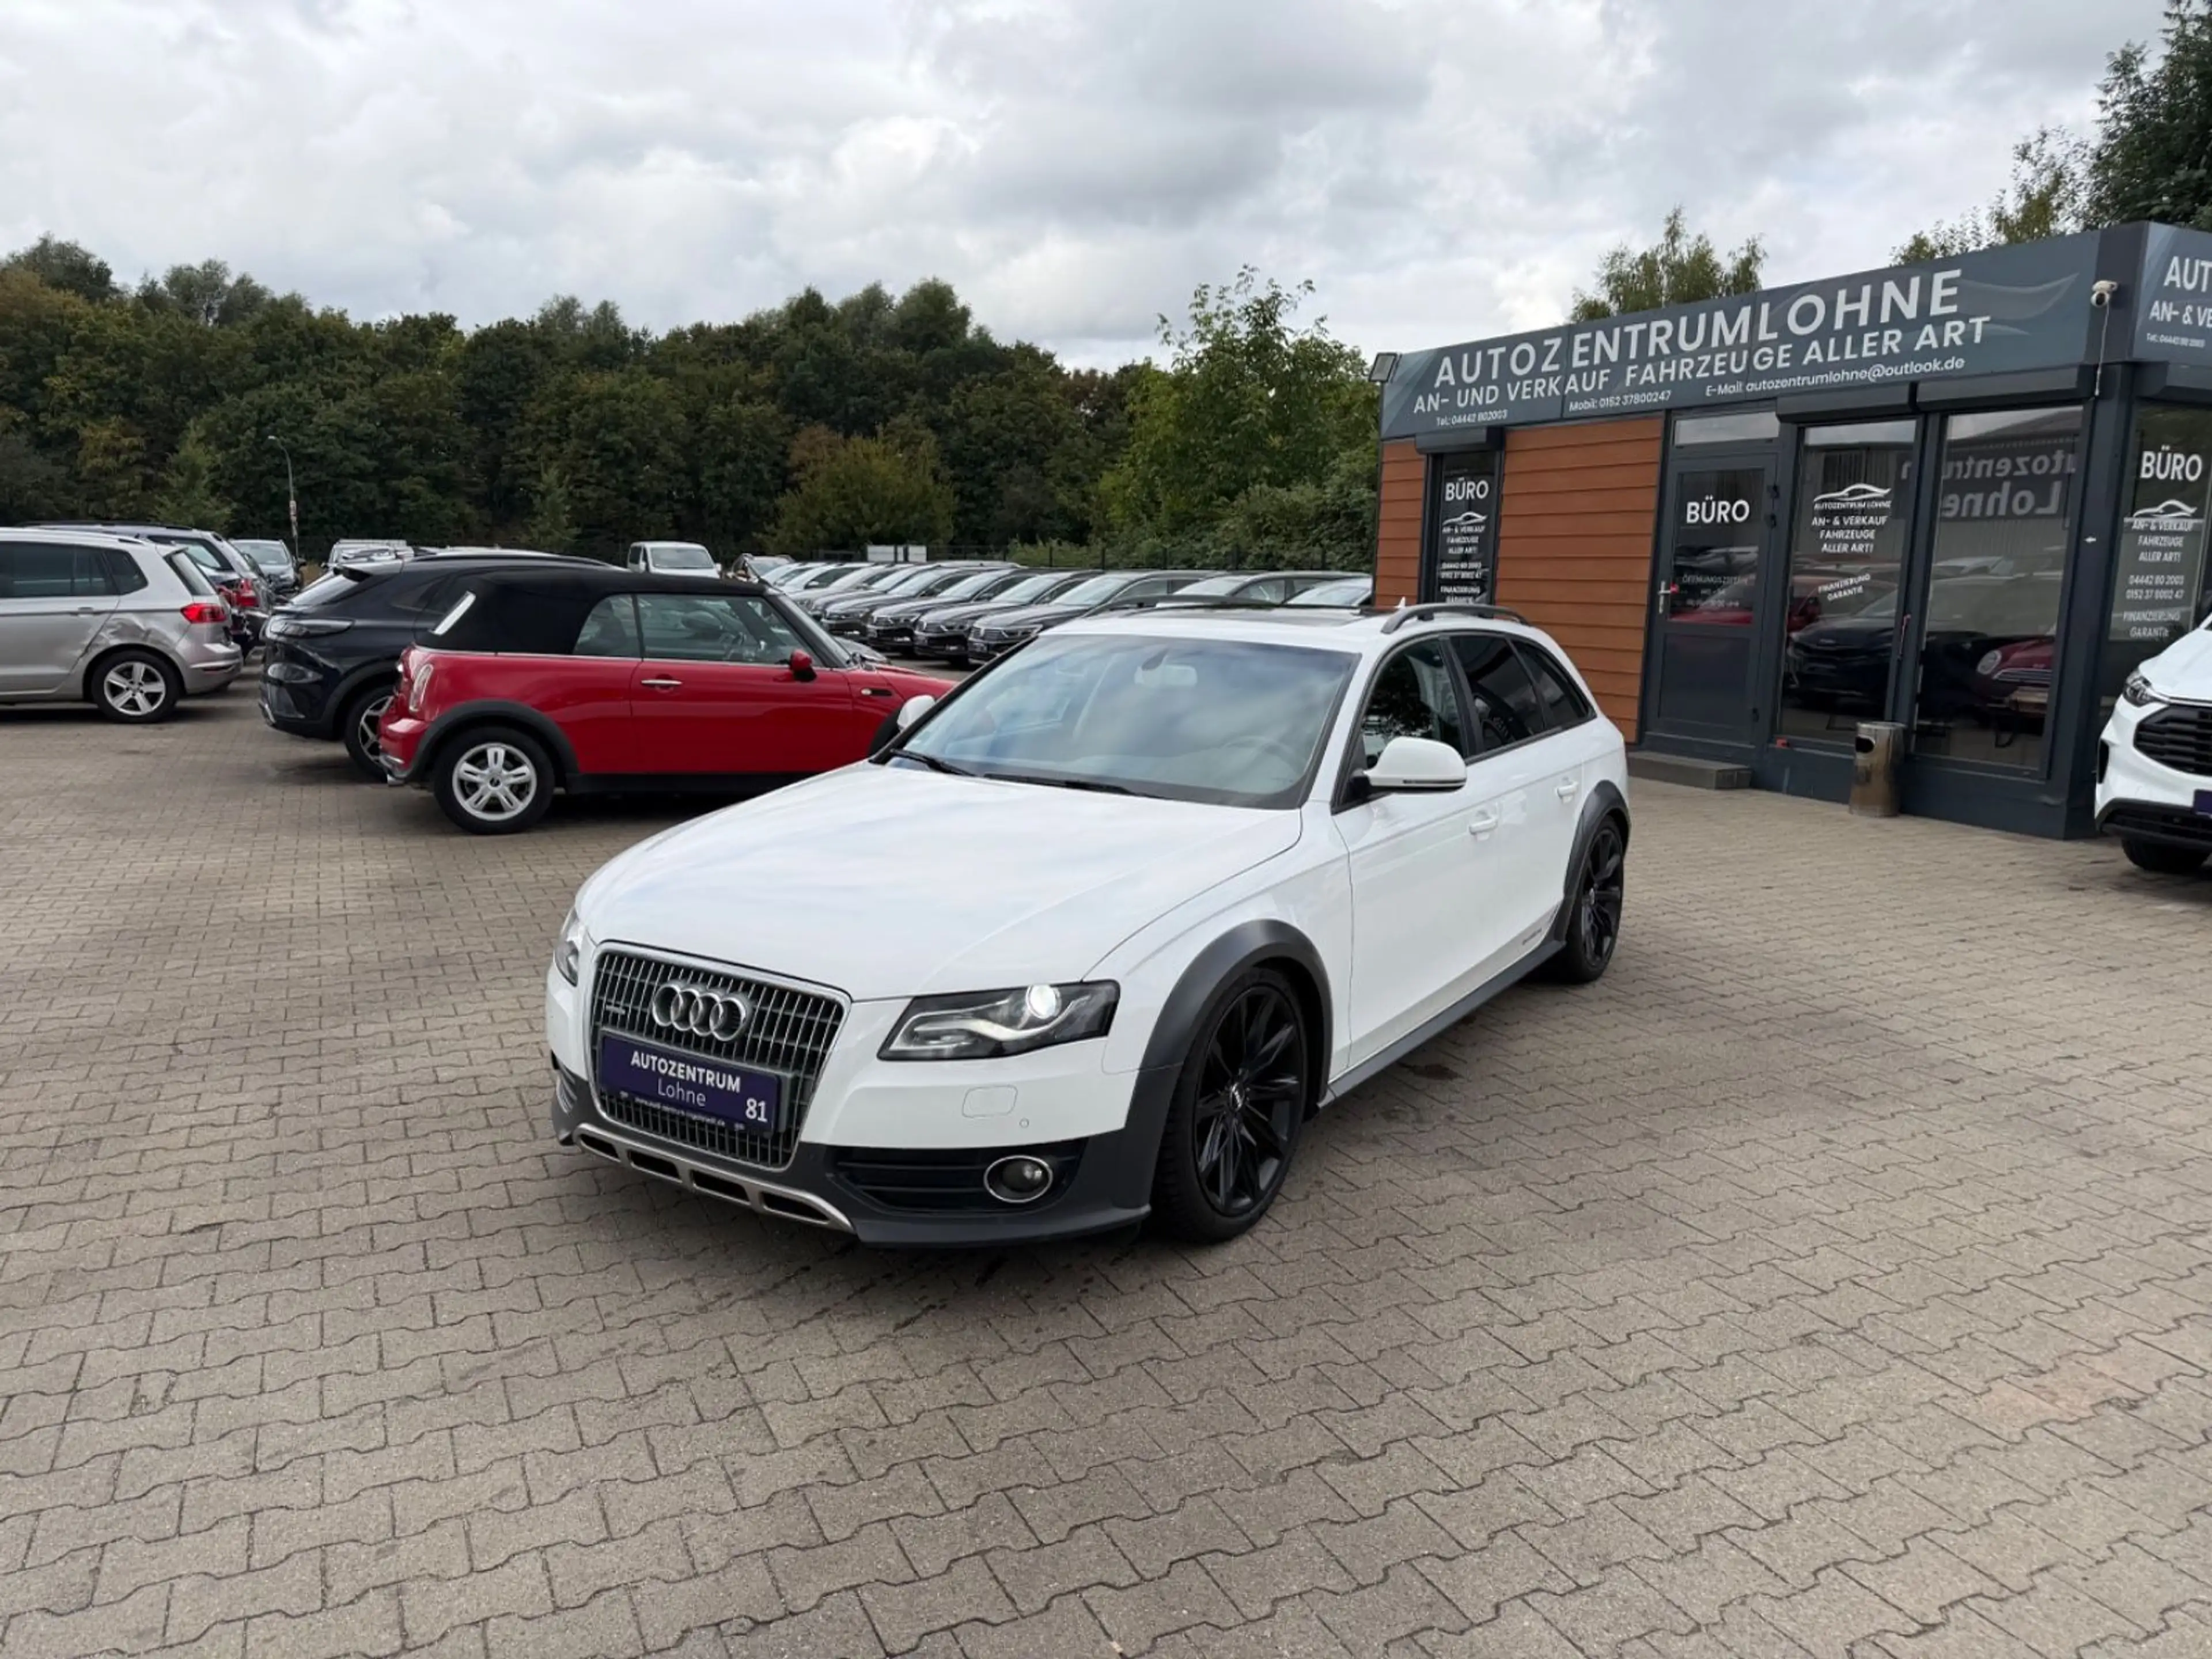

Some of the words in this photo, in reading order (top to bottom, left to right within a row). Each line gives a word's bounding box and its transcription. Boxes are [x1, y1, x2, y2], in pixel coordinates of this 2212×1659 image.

[2149, 300, 2180, 323] AN-
[2182, 304, 2194, 325] &
[1413, 392, 1450, 414] AN-
[1456, 385, 1499, 408] UND
[1506, 369, 1611, 402] VERKAUF
[1625, 343, 1793, 387] FAHRZEUGE
[1802, 328, 1903, 366] ALLER
[1914, 316, 1992, 351] ART
[2139, 444, 2203, 482] BÜRO
[1445, 476, 1489, 502] BÜRO
[1686, 494, 1750, 524] BÜRO
[1810, 517, 1831, 527] AN-
[1842, 515, 1889, 527] VERKAUF
[1819, 529, 1876, 540] FAHRZEUGE
[1821, 543, 1850, 553] ALLER
[630, 1050, 741, 1094] AUTOZENTRUM
[657, 1077, 707, 1108] Lohne
[745, 1097, 768, 1123] 81
